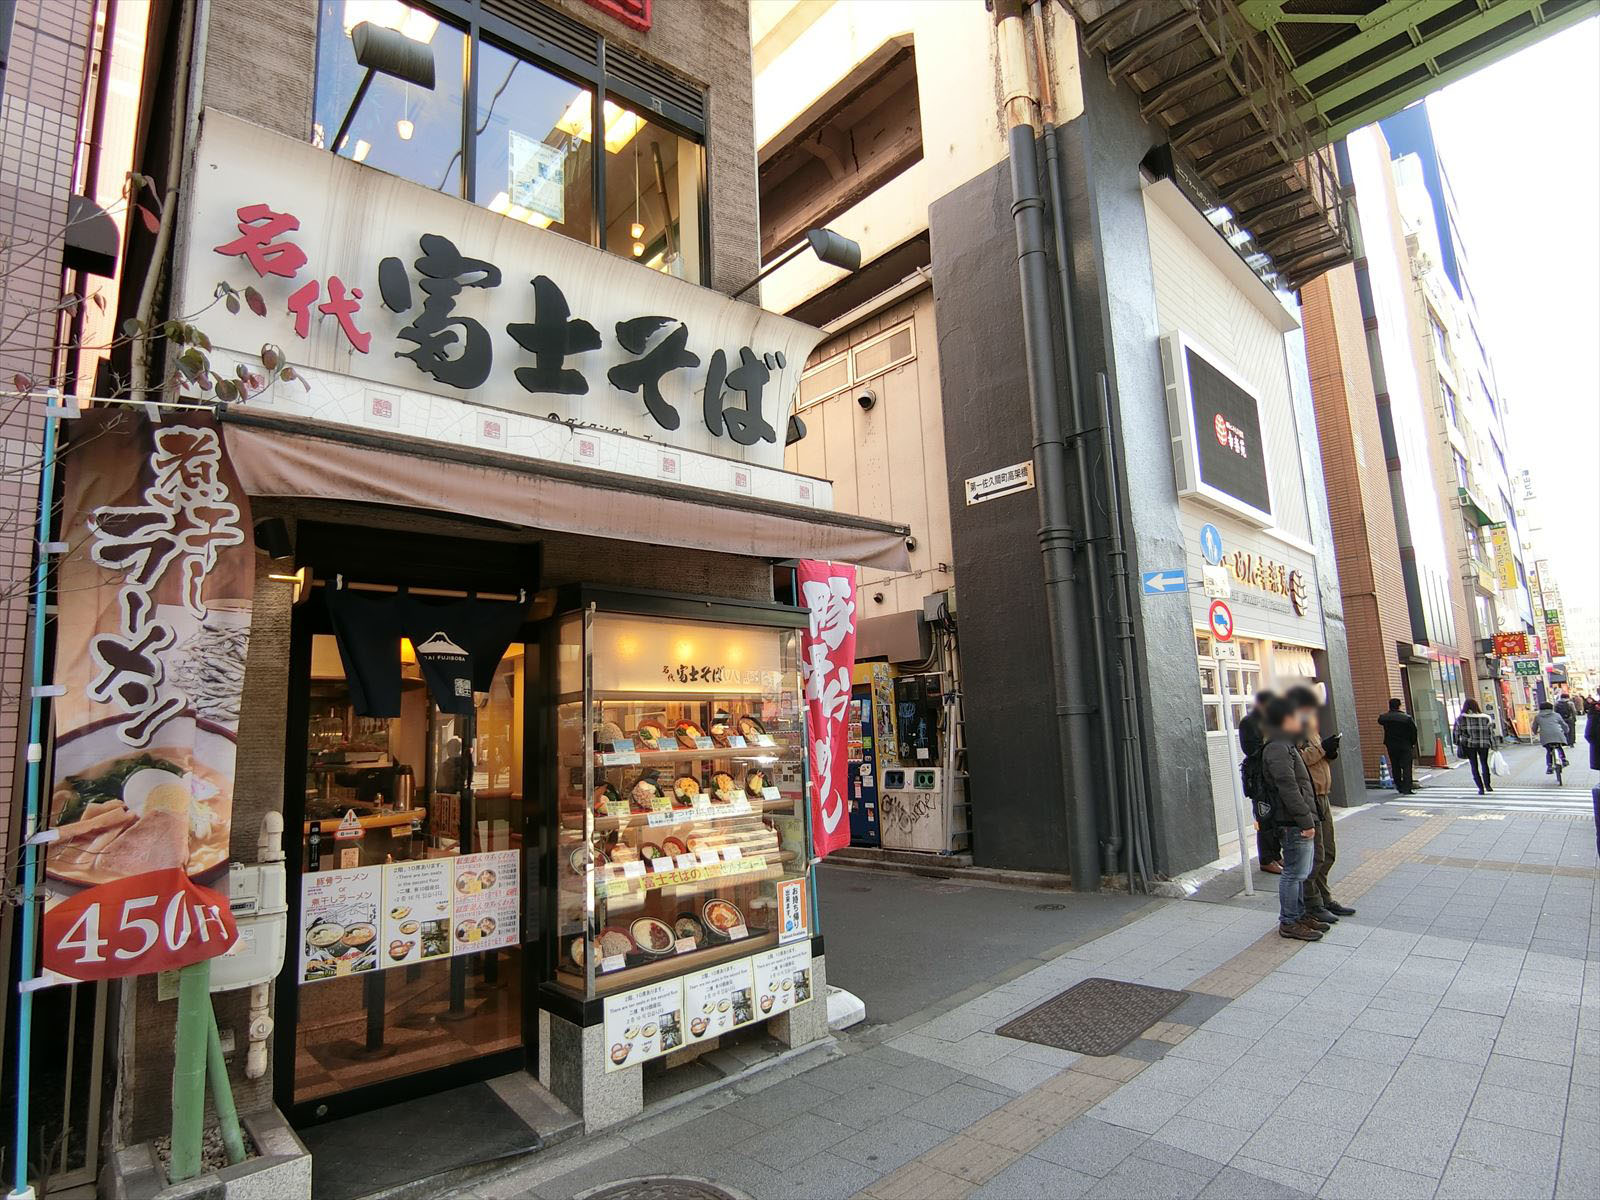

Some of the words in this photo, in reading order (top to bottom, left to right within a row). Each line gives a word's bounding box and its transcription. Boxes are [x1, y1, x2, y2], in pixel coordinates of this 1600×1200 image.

[213, 204, 372, 354] 名代
[378, 233, 787, 446] 富士そば
